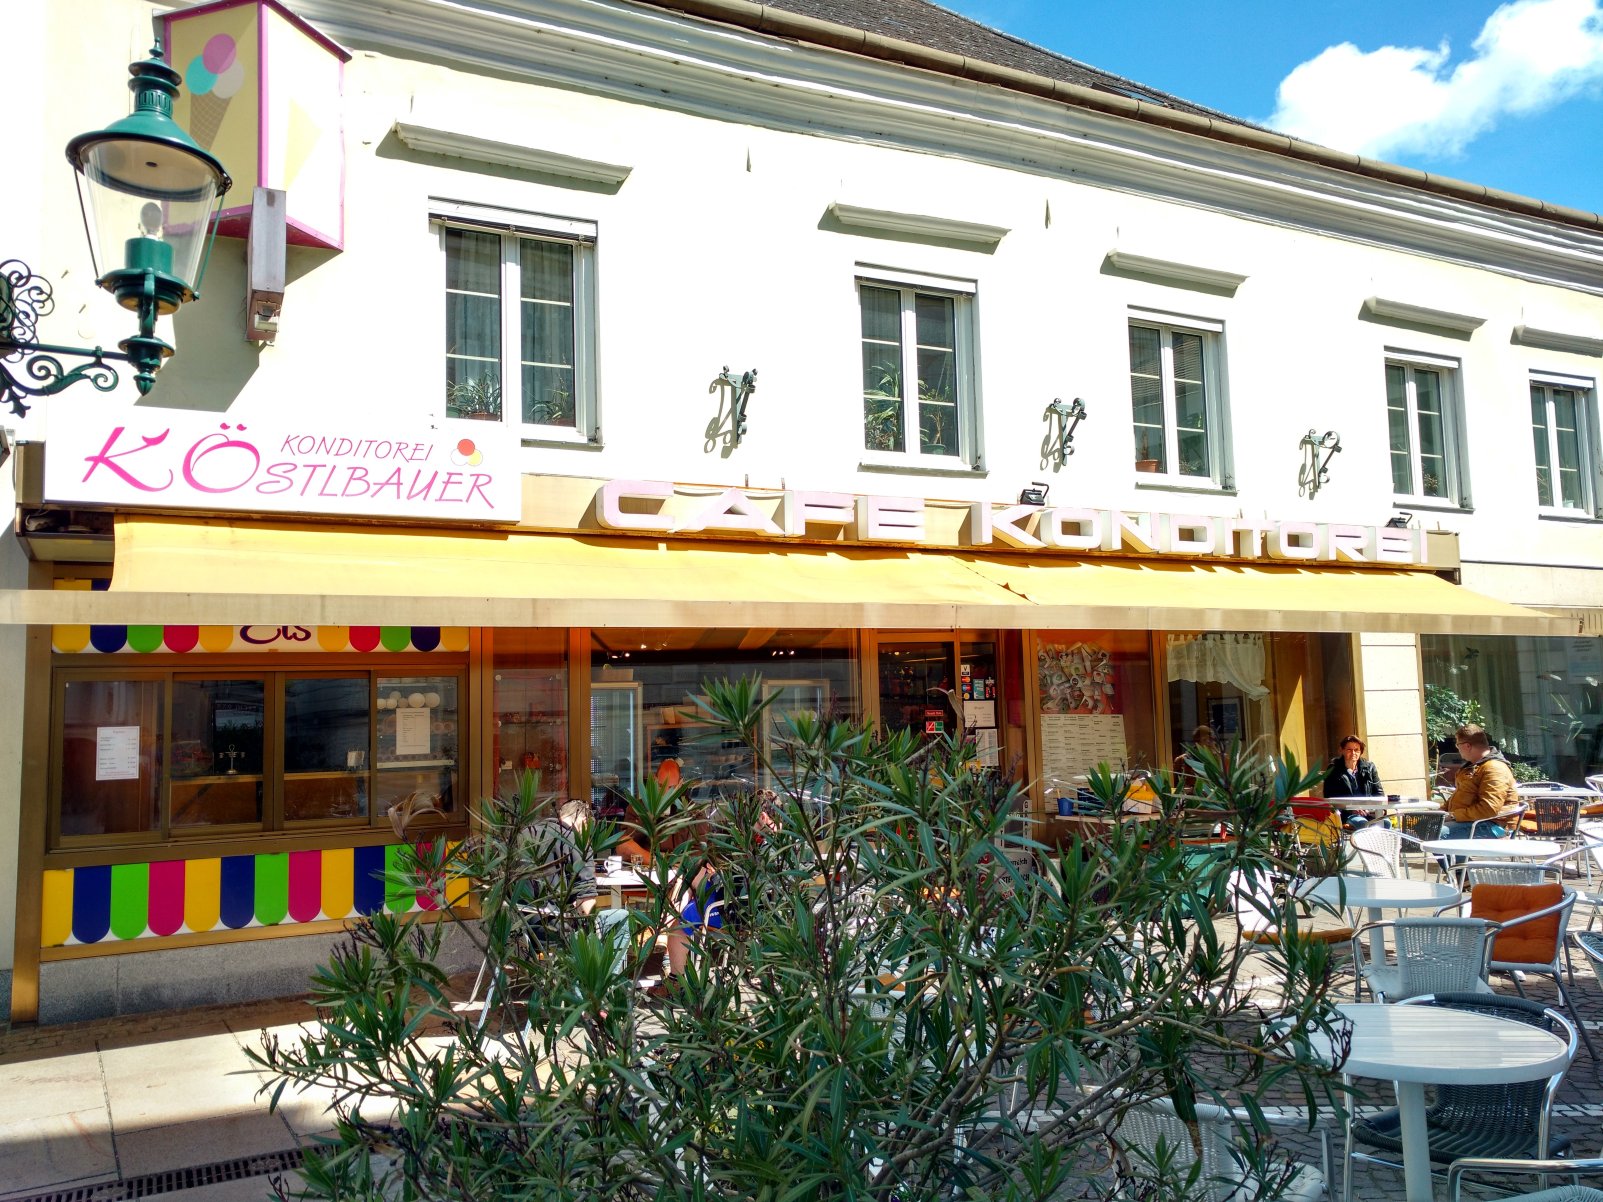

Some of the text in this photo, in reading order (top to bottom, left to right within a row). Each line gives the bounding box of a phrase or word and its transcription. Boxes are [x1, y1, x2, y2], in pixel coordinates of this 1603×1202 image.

[82, 422, 495, 509] KÖSTLBAUER
[281, 434, 433, 463] KONDITOREI
[596, 479, 1428, 564] CAFE KONDITOREI
